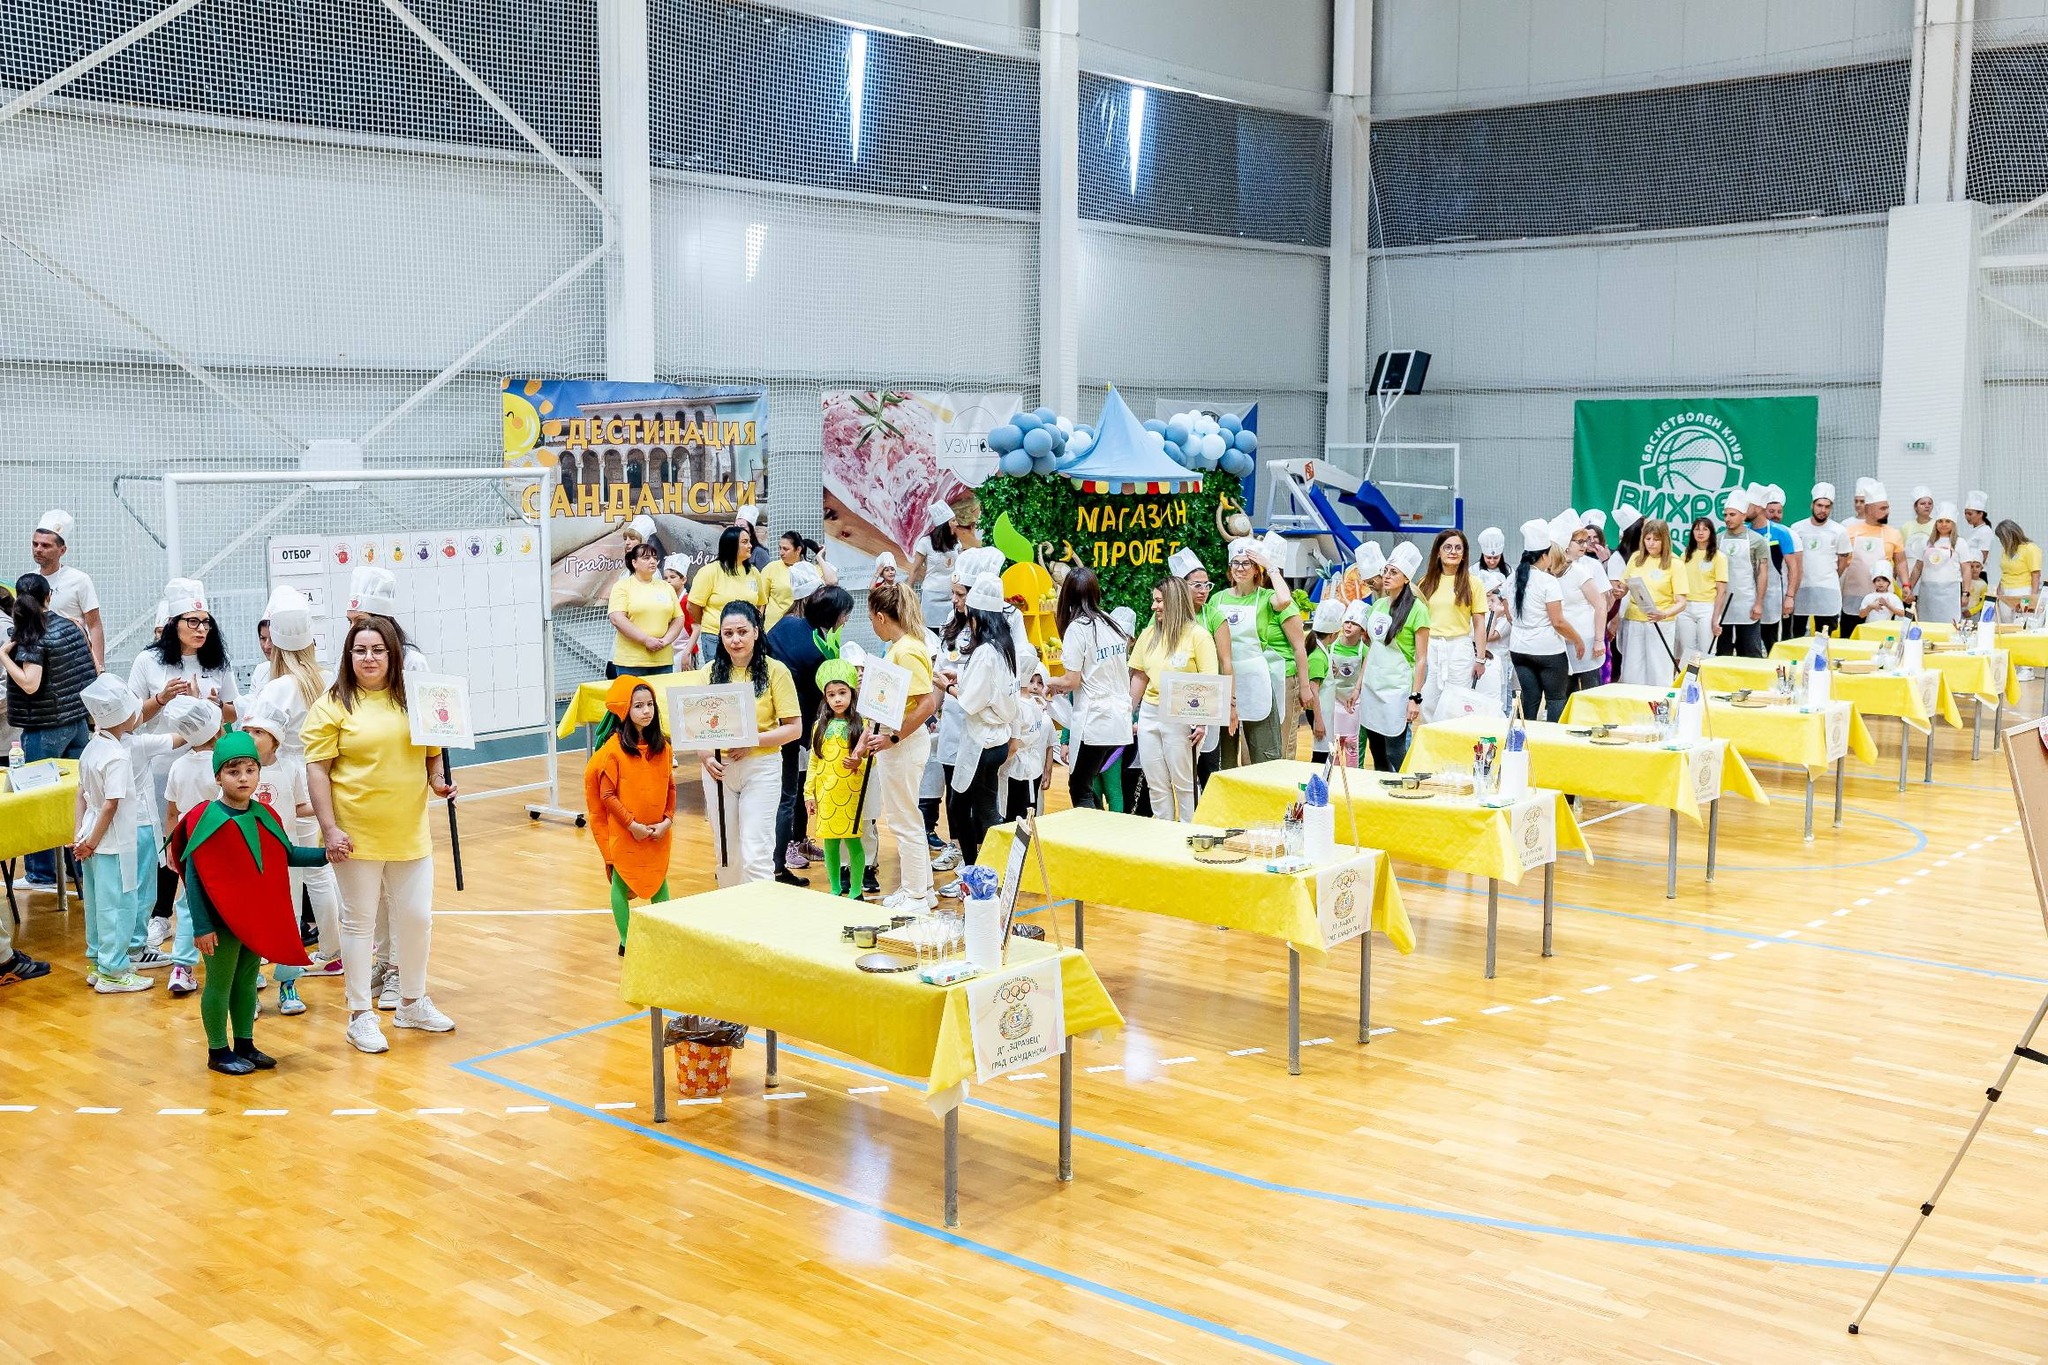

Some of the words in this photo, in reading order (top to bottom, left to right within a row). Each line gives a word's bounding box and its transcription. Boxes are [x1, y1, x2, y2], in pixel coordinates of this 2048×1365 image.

[566, 419, 757, 450] ДЕСТИНАЦИЯ
[1641, 411, 1723, 463] БАСКЕТБОЛЕН
[1720, 425, 1744, 462] КЛУБ
[521, 480, 757, 523] САНДАНСКИ
[1076, 499, 1187, 533] МАГАЗИН
[1617, 484, 1729, 524] ВИХРЕ
[281, 549, 311, 561] ОТБОР
